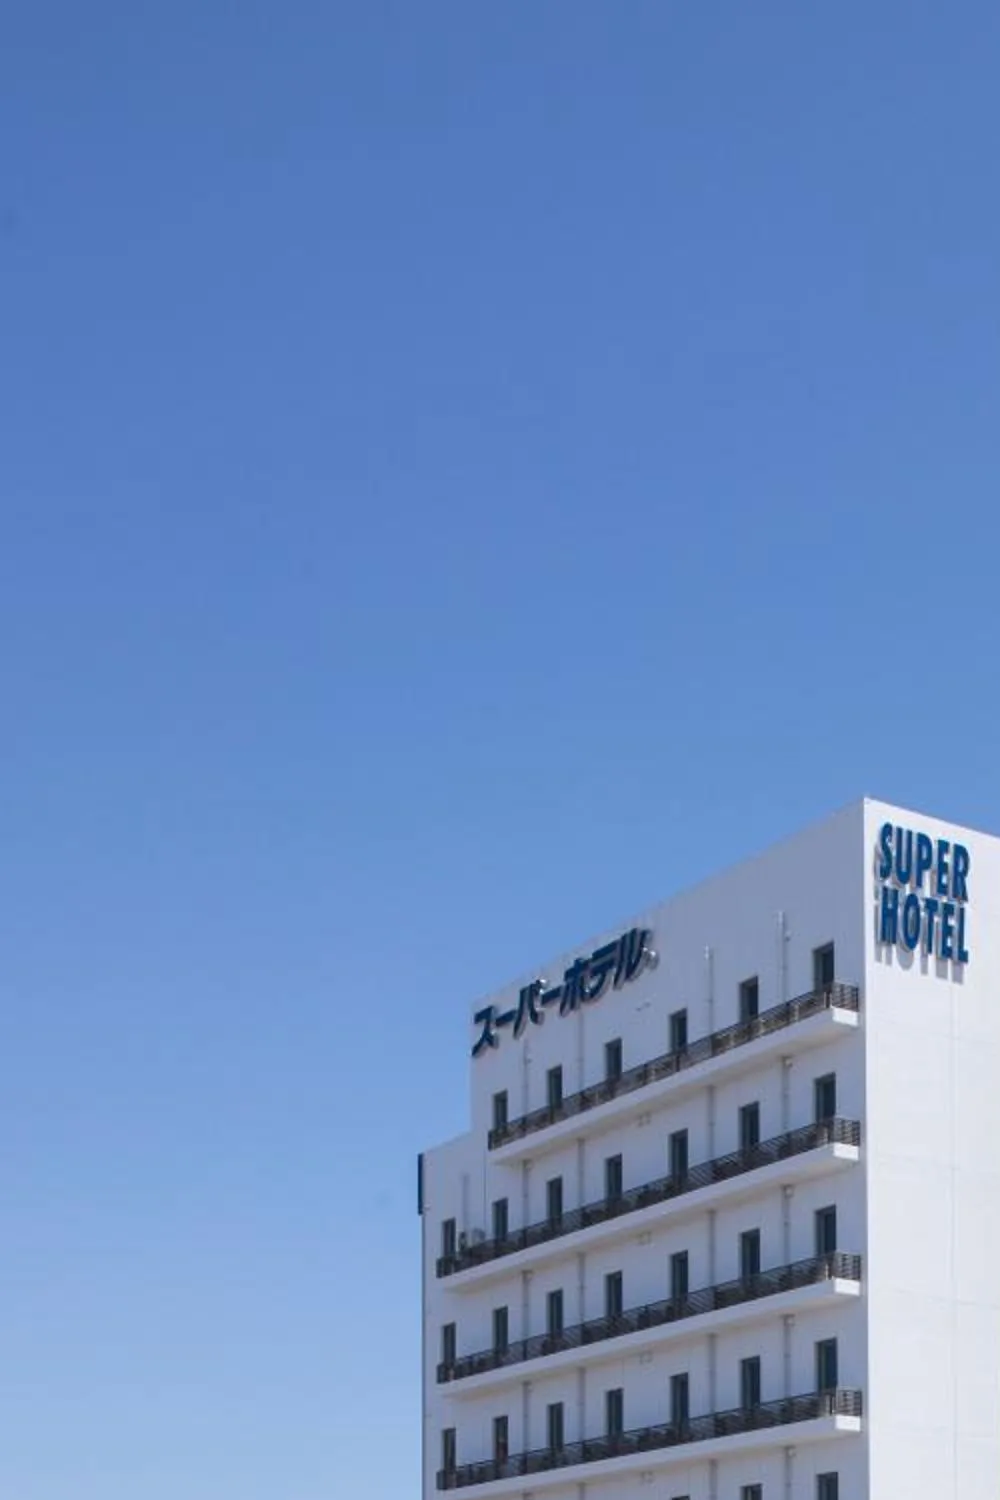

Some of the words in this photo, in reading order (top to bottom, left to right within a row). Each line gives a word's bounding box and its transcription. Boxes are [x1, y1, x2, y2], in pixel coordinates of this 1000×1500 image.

[879, 822, 970, 902] SUPER
[881, 885, 969, 963] HOTEL
[471, 928, 652, 1057] スーパーホテル
